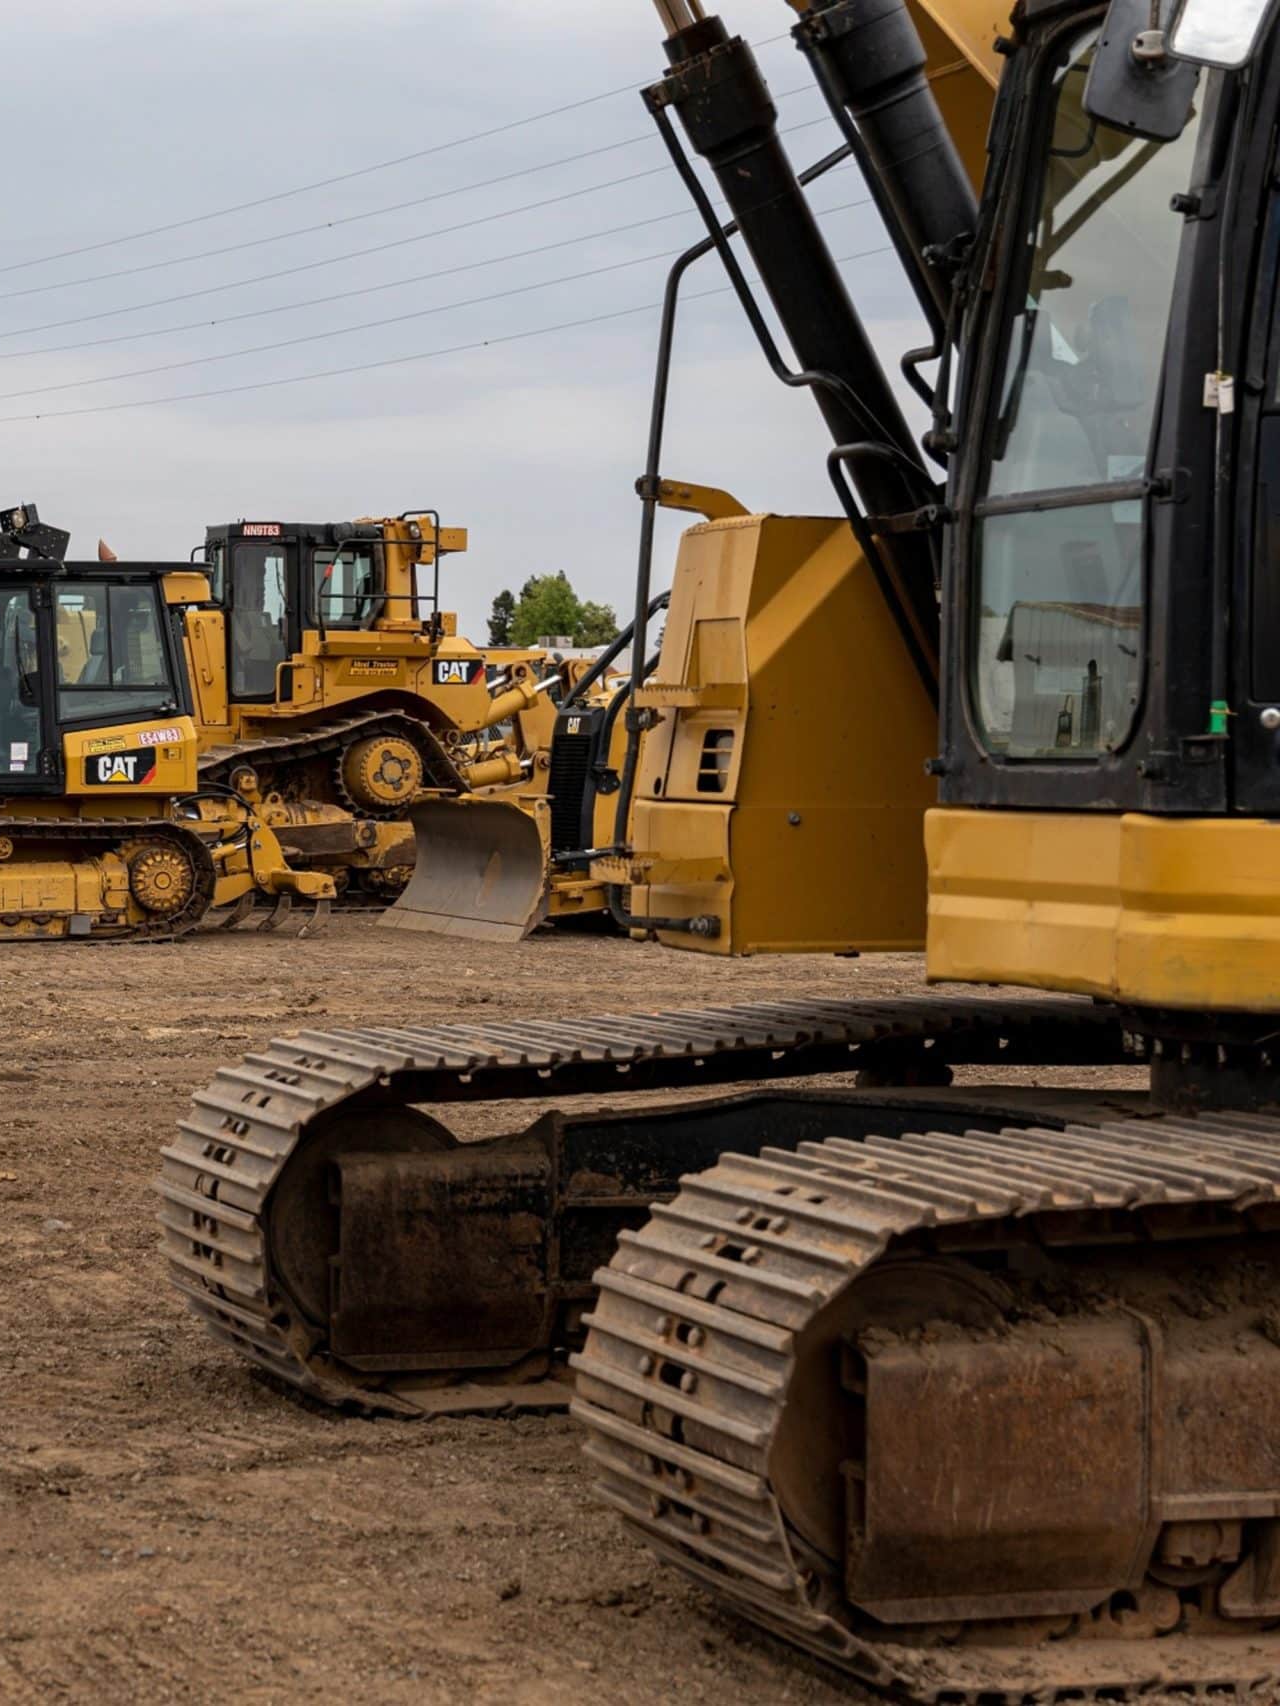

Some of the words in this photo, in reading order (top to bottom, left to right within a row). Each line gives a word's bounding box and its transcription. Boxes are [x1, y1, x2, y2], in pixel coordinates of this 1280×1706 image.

[438, 661, 470, 683] CAT
[567, 716, 581, 735] CAT
[98, 756, 137, 782] CAT
